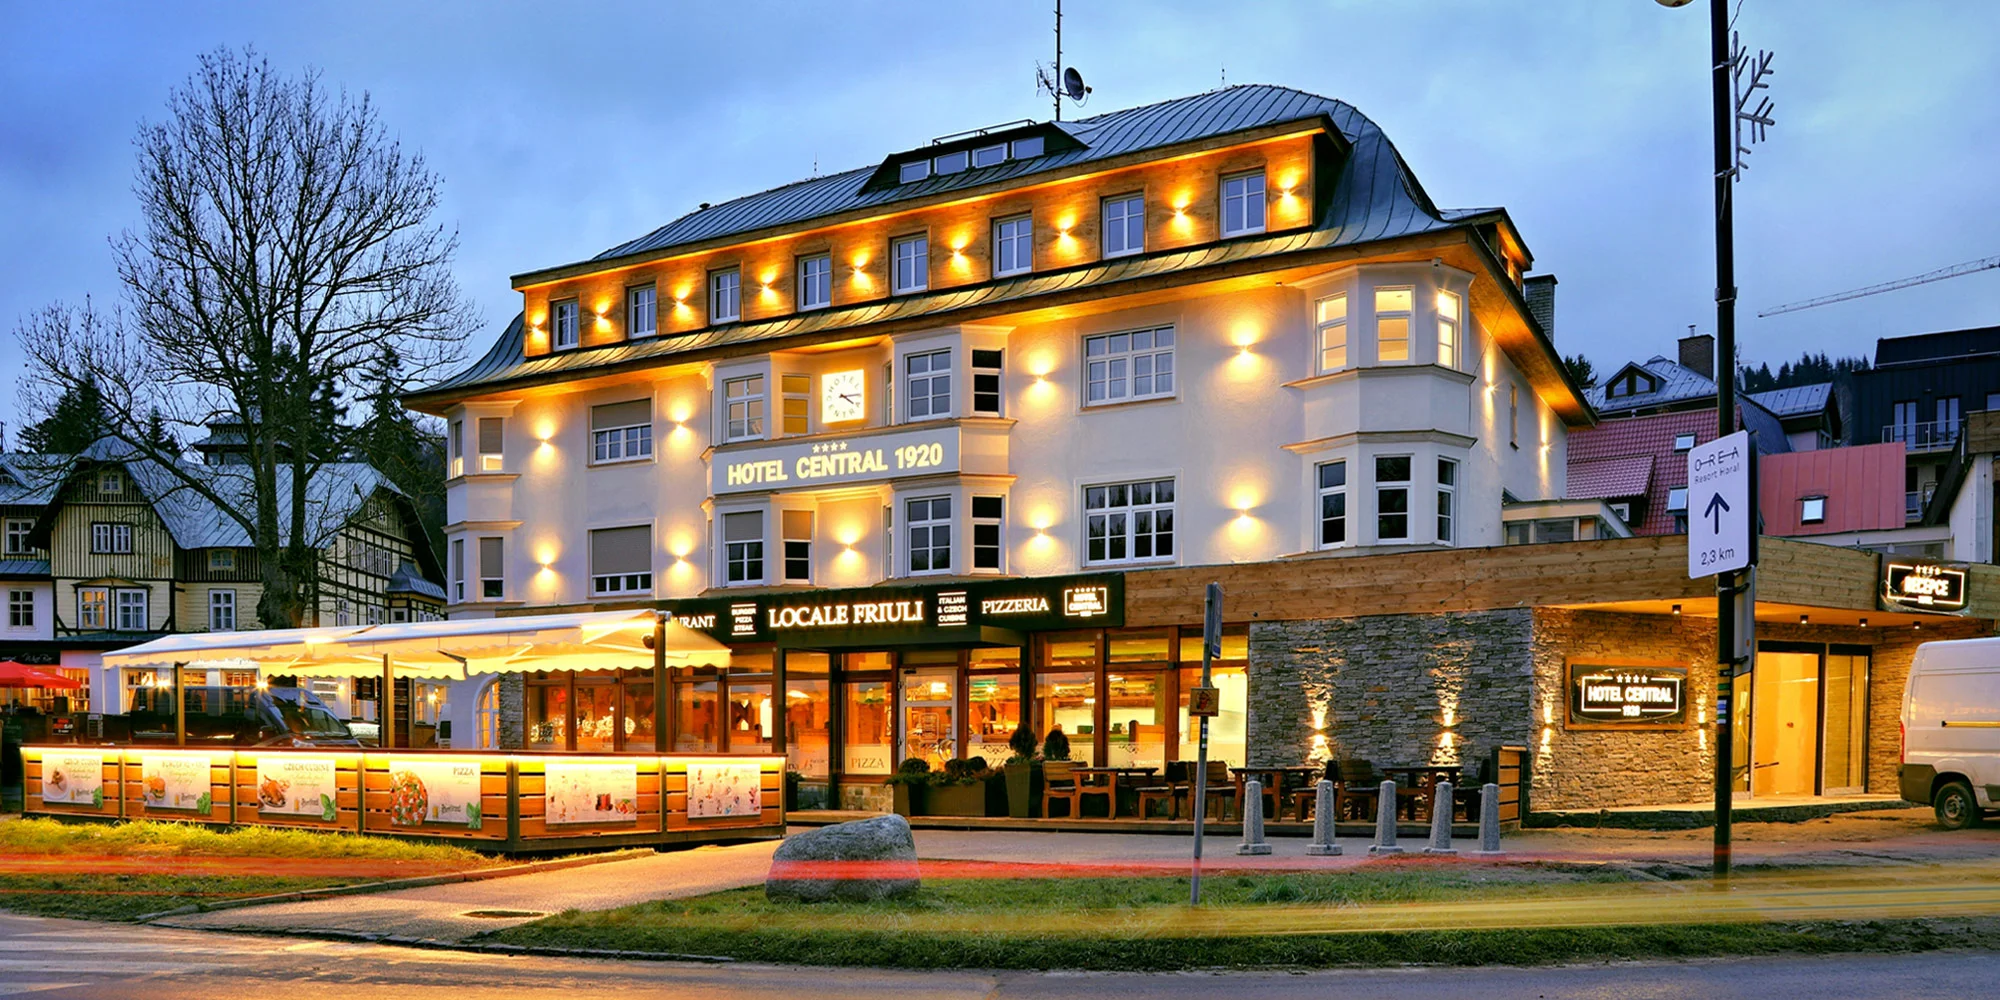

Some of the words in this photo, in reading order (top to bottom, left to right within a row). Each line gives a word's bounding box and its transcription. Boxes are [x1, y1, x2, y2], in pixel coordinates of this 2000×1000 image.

[727, 459, 788, 486] HOTEL
[795, 449, 889, 480] CENTRAL
[894, 443, 943, 469] 1920
[1695, 470, 1717, 484] Resort
[1719, 461, 1740, 477] Horal
[1701, 549, 1716, 567] 2,3
[1719, 547, 1735, 562] km
[938, 596, 966, 605] ITALIAN
[937, 605, 943, 614] &
[943, 604, 968, 614] CZECH
[981, 597, 1050, 615] PIZZERIA
[731, 607, 757, 616] BURGER
[768, 605, 849, 628] LOCALE
[853, 601, 924, 624] FRIULI
[735, 616, 753, 624] PIZZA
[938, 613, 967, 622] CUISINE
[734, 624, 754, 632] STEAK
[1587, 686, 1624, 702] HOTEL
[1624, 686, 1674, 703] CENTRAL
[851, 758, 885, 769] PIZZA
[453, 766, 475, 776] PIZZA
